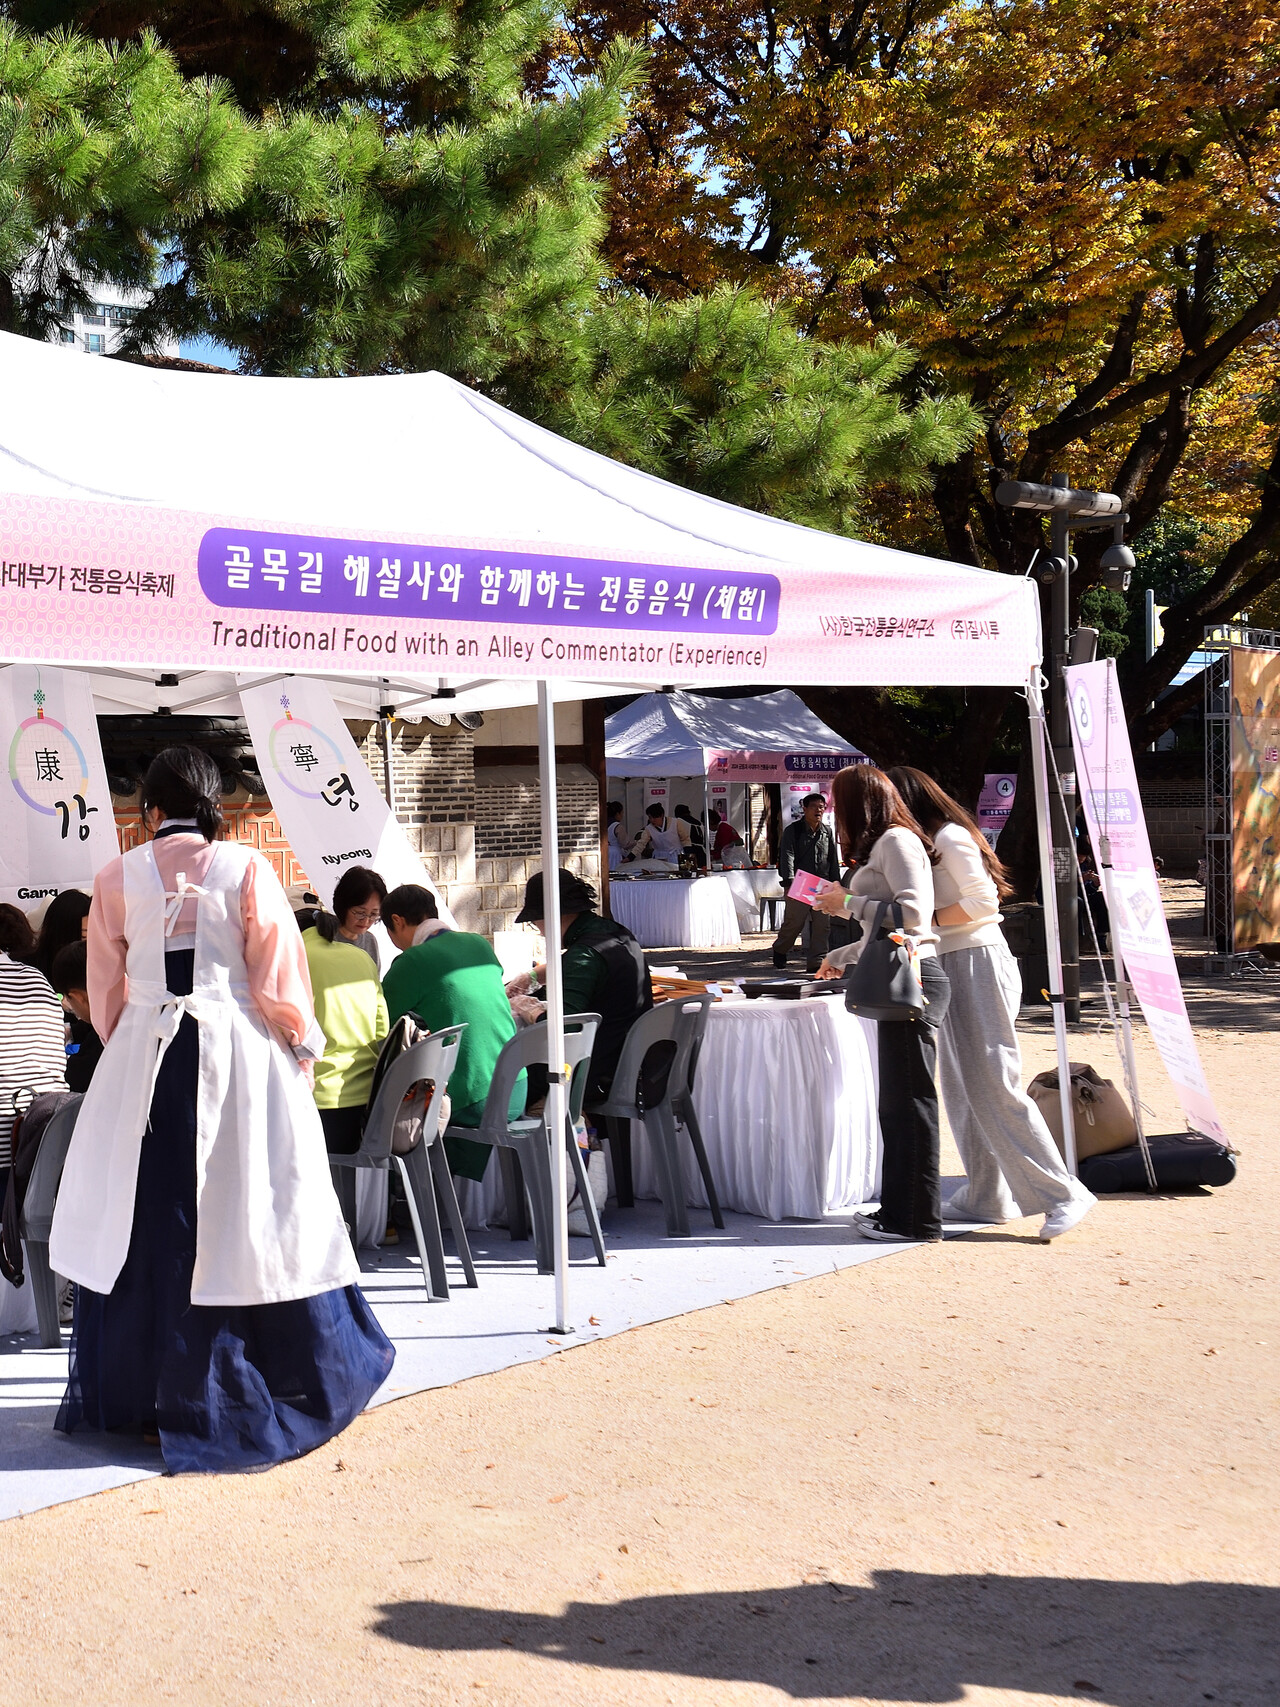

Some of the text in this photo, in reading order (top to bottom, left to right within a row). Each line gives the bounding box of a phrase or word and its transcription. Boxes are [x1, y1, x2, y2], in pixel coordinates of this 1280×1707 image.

[70, 567, 175, 598] 전통음식축제
[224, 545, 324, 594] 골목길
[343, 554, 464, 603] 해설사와
[479, 565, 585, 610] 함께하는
[598, 576, 696, 617] 전통음식
[212, 621, 767, 668] Traditional Food with an Alley Commentator (Experience)
[35, 748, 64, 781] 康
[289, 743, 319, 772] 寧
[320, 773, 360, 812] 녕
[1002, 783, 1009, 792] 4
[55, 794, 98, 841] 강
[321, 848, 373, 865] Nyeong
